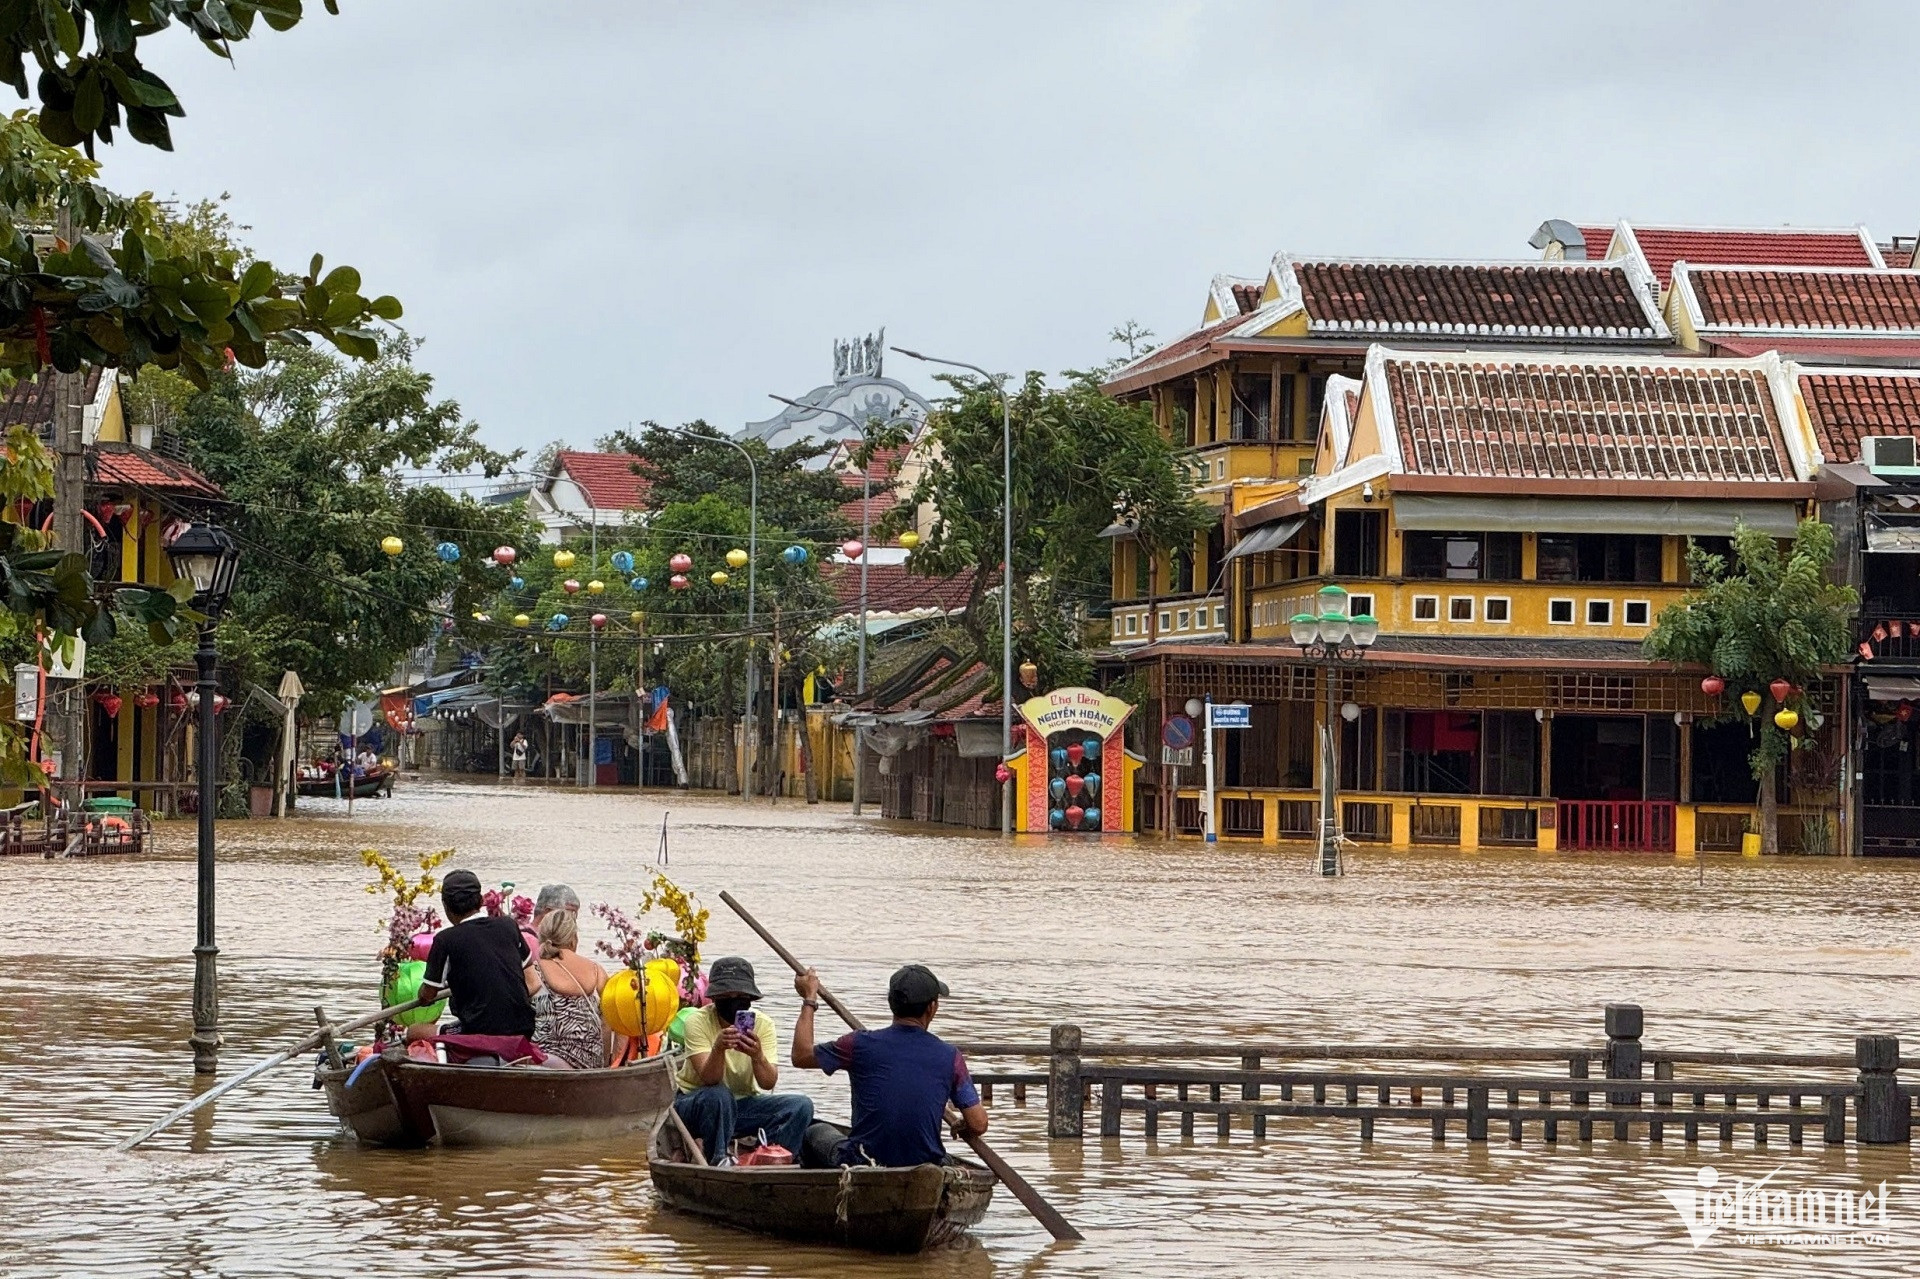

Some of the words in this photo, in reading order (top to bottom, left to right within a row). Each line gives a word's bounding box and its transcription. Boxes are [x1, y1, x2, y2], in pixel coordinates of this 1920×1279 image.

[1050, 694, 1072, 706] Chợ
[1079, 708, 1115, 726] HOÀNG
[1048, 719, 1071, 729] NIGHT
[1072, 718, 1104, 729] MARKET
